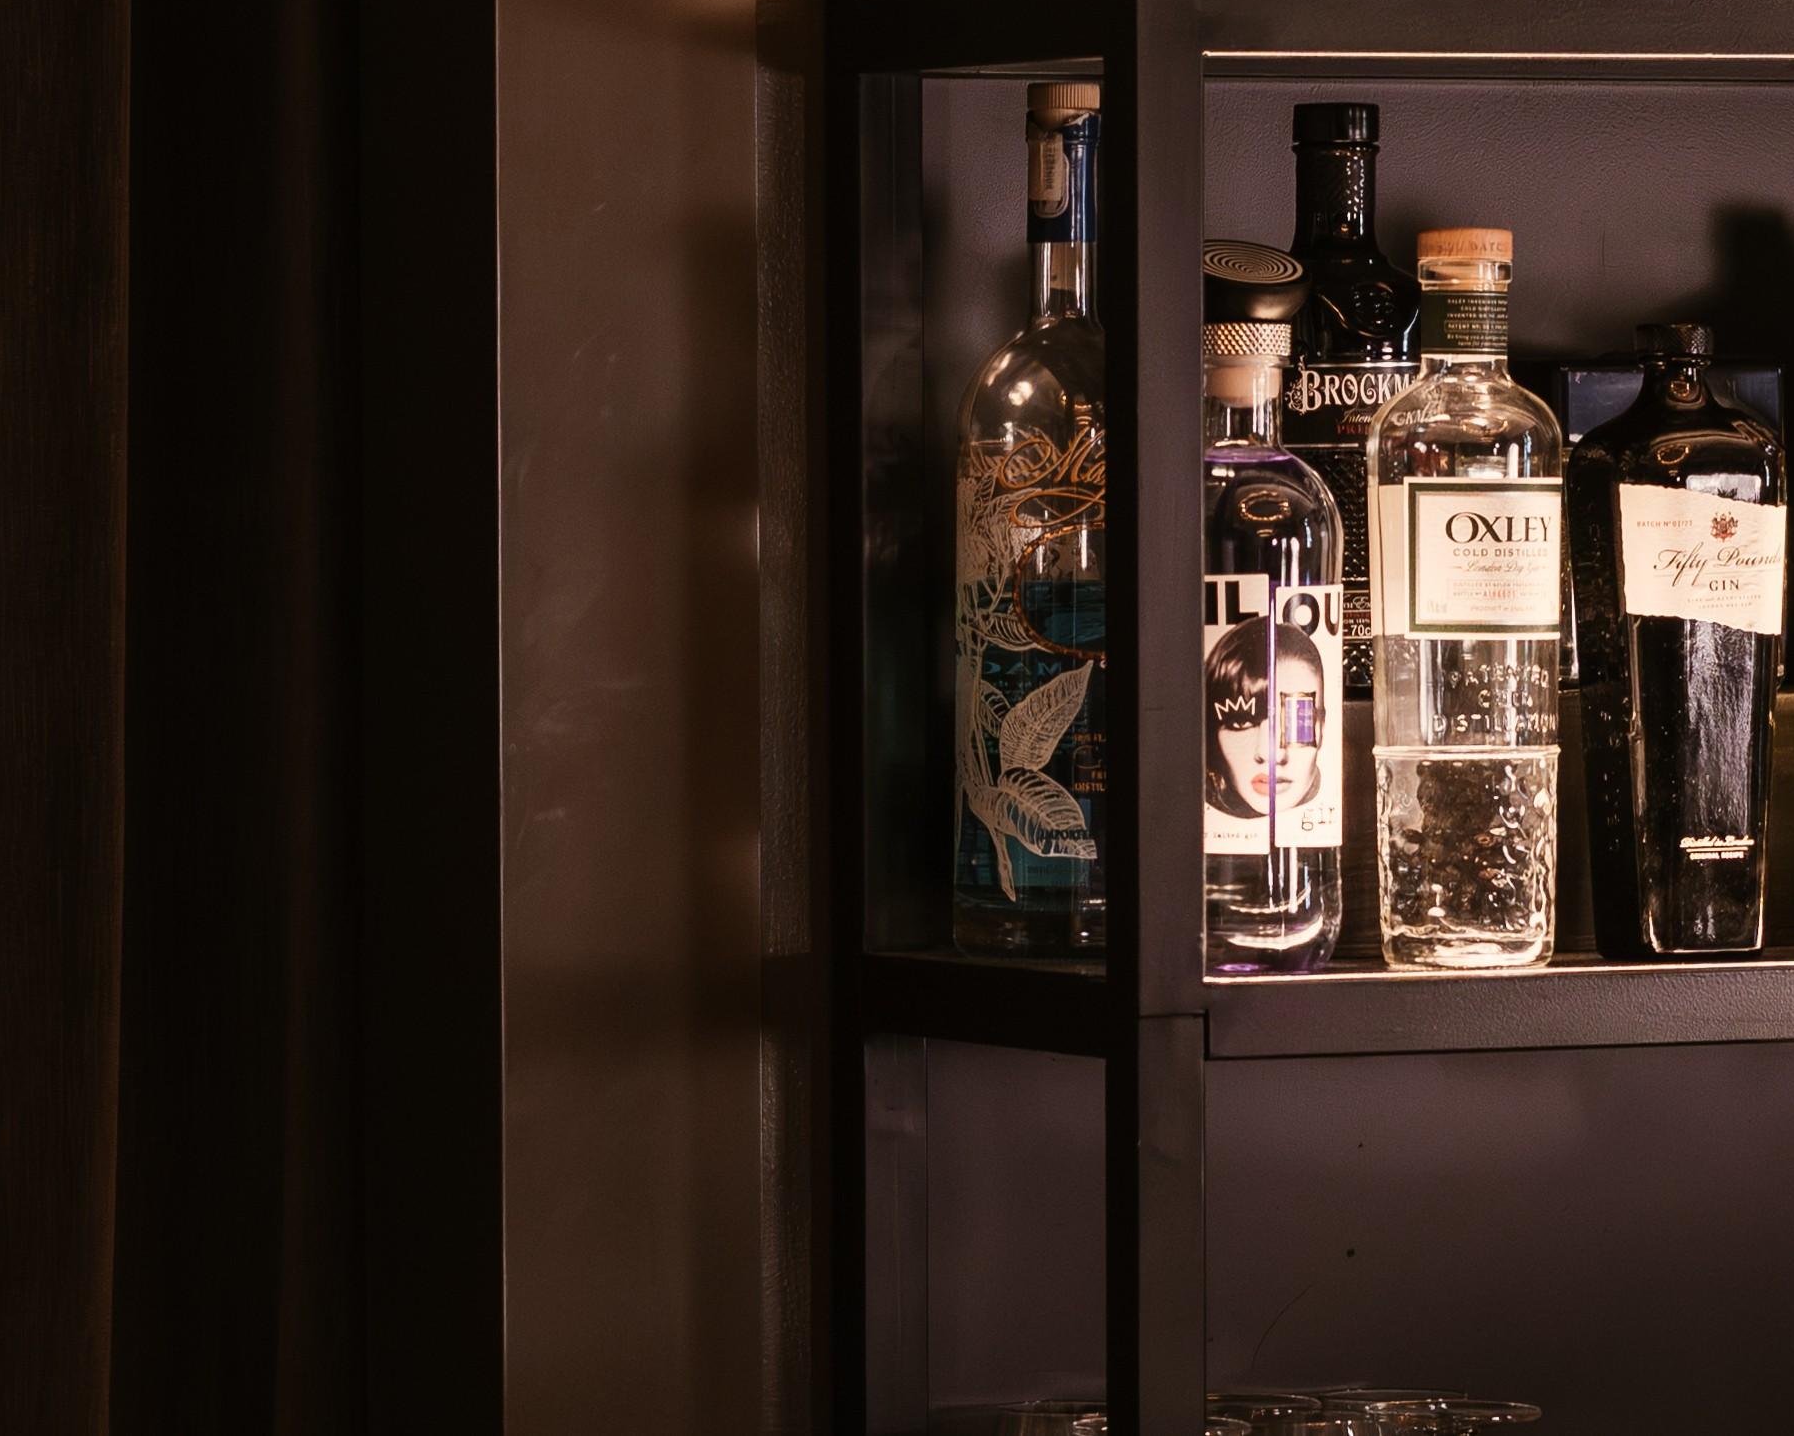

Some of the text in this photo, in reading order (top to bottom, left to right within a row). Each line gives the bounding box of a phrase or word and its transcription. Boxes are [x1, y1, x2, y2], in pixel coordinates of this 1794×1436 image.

[1299, 369, 1410, 413] BROCKM
[1445, 511, 1552, 544] OXLEY
[1636, 520, 1661, 528] BATCH
[1452, 548, 1489, 557] COLD
[1653, 541, 1709, 587] Fifty
[1709, 579, 1740, 592] GIN
